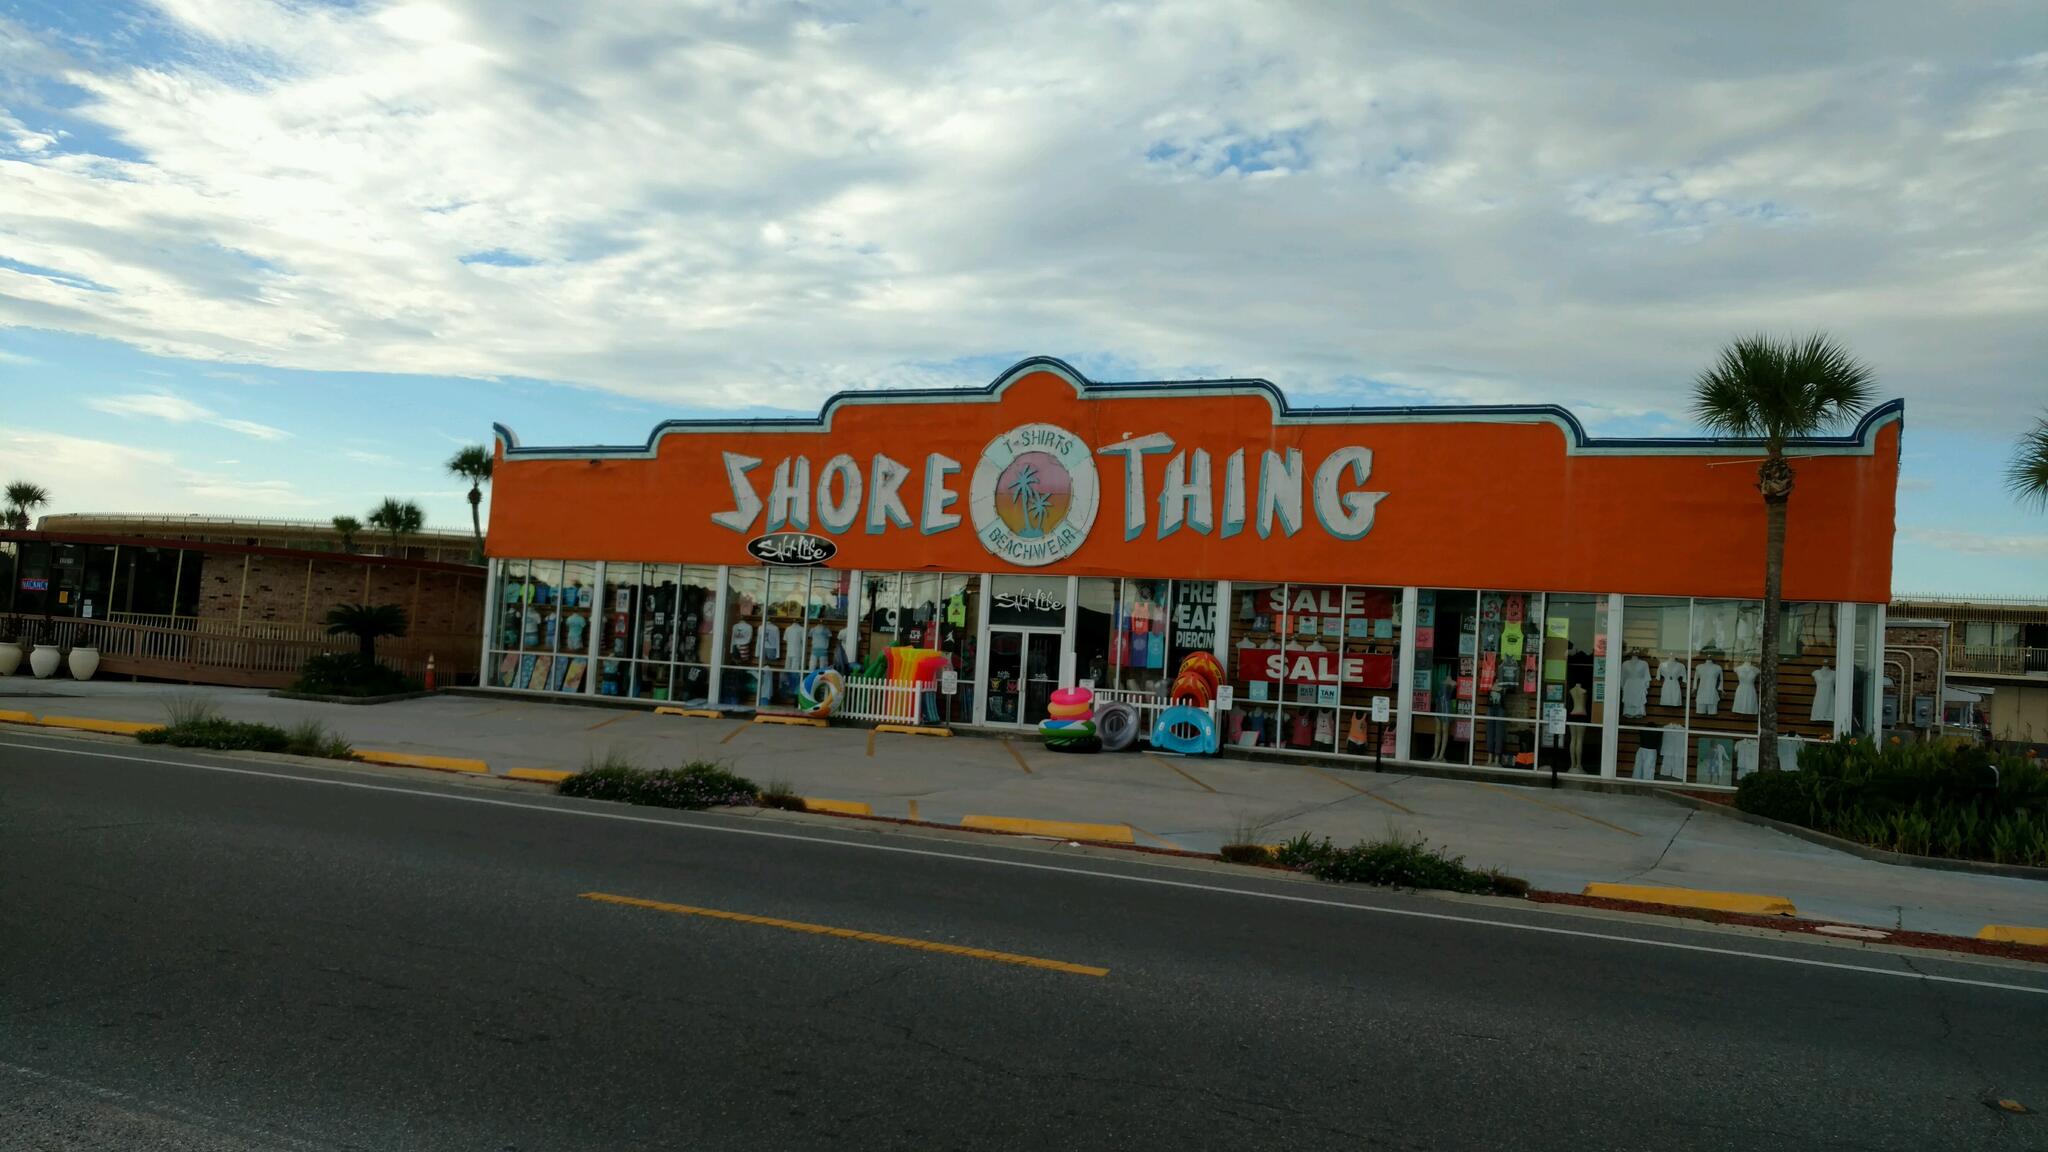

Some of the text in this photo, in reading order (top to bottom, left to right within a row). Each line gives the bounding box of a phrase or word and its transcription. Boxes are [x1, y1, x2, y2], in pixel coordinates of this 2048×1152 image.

[1002, 430, 1073, 456] T-SHIRTS
[711, 431, 1389, 542] SHORE THING
[988, 527, 1076, 561] BEACHWEAR
[875, 592, 912, 609] PIERCNG
[1269, 587, 1366, 616] SALE
[1178, 604, 1217, 630] EAR
[1175, 630, 1215, 649] PIERCIN
[1265, 654, 1365, 682] SALE
